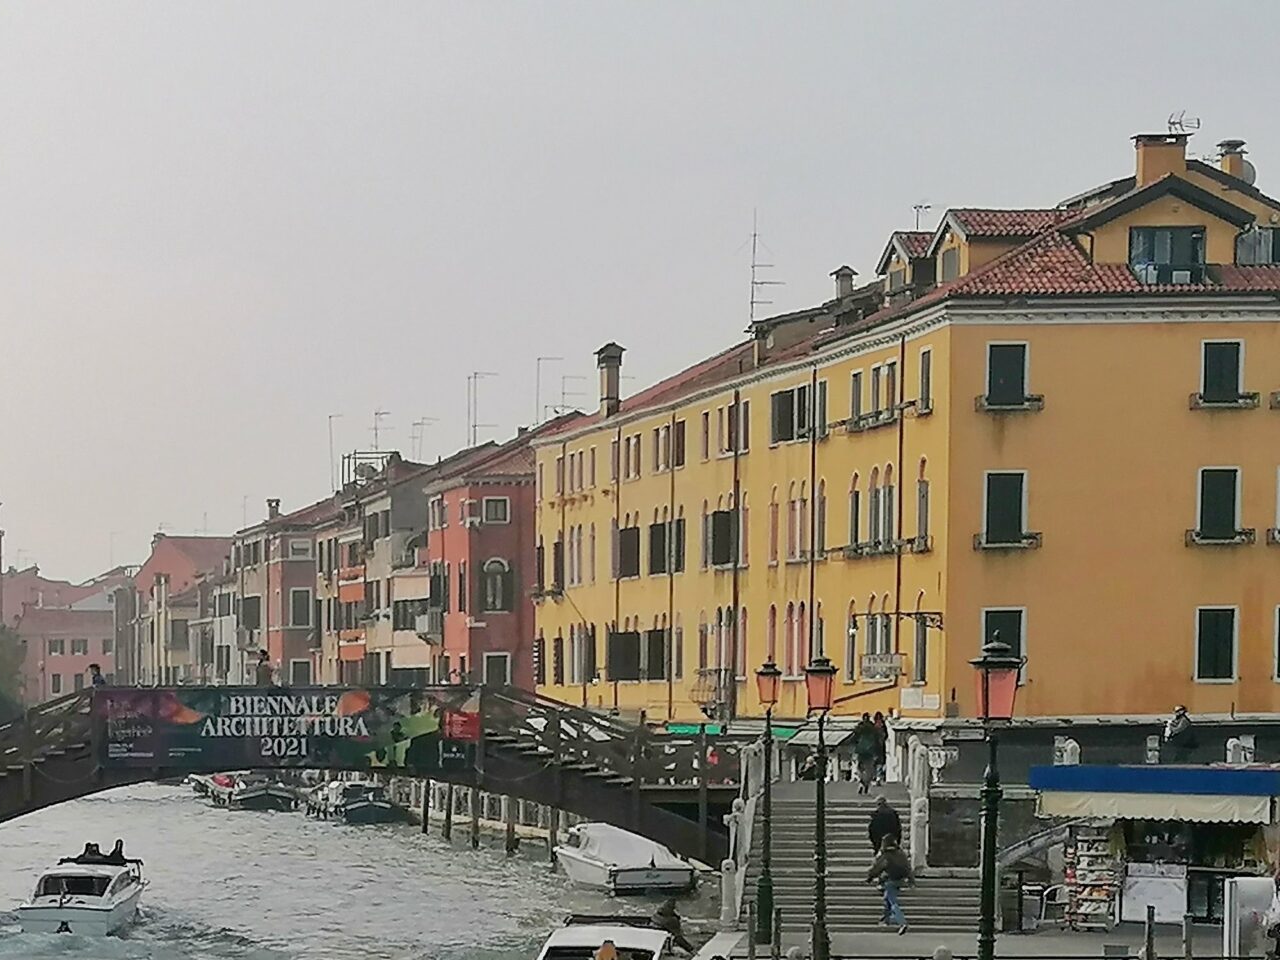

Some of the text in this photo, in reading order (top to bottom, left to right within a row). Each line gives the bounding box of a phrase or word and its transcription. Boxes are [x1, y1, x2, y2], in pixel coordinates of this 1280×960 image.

[230, 695, 339, 716] BIENNALE
[201, 716, 370, 737] ARCHITETTURA
[261, 737, 308, 757] 2021
